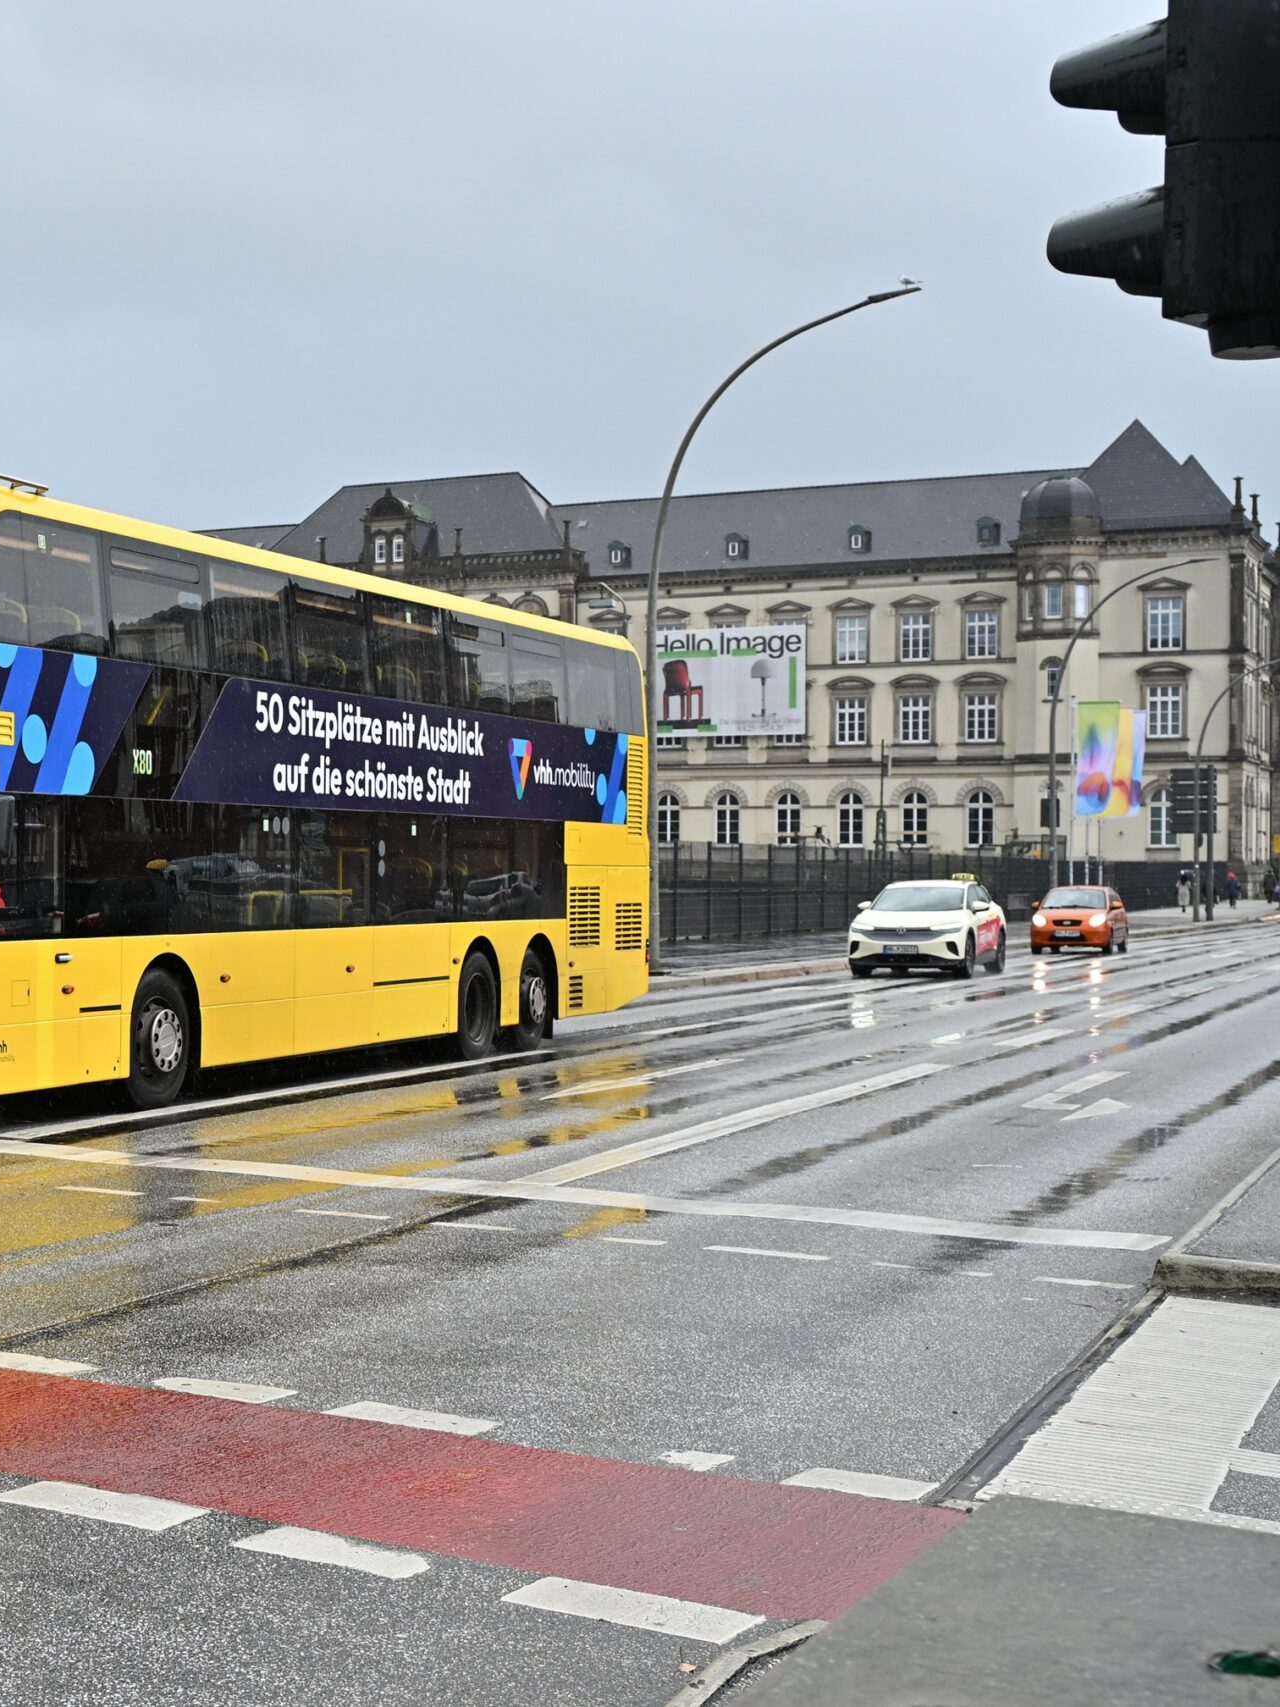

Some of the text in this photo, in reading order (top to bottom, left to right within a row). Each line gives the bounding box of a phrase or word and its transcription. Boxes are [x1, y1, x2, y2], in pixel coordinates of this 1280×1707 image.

[720, 632, 802, 659] Image
[255, 691, 485, 757] 50 Sitzplätze mit Ausblick
[132, 748, 153, 775] X80
[273, 753, 471, 805] auf die schönste Stadt
[533, 758, 596, 796] vhh.mobility
